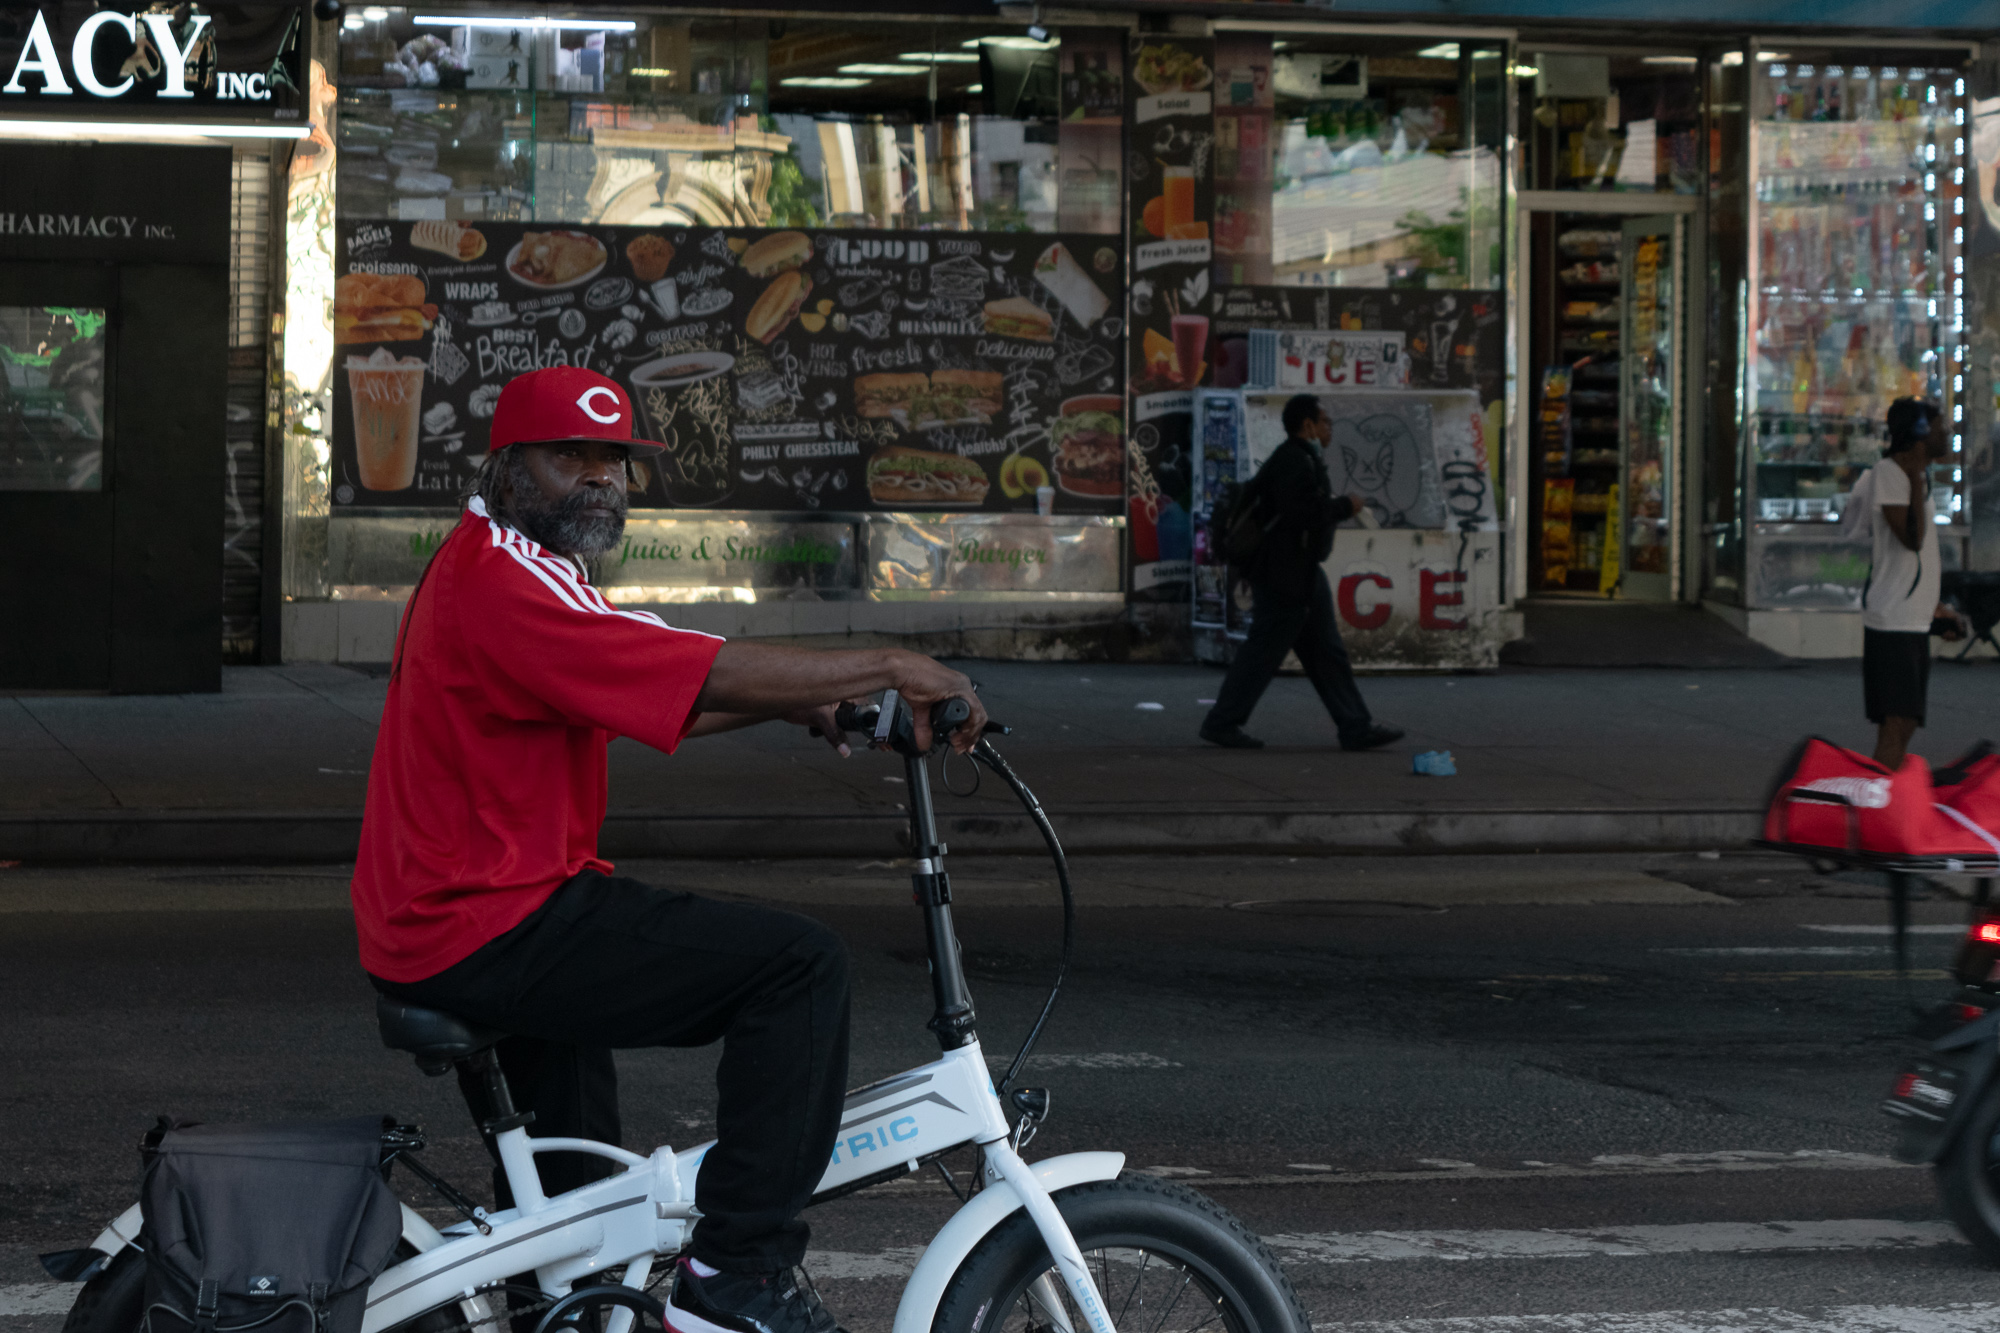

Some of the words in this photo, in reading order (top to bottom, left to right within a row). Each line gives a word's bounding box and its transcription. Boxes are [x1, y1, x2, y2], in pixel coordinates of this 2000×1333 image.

[2, 8, 212, 98] ACY
[216, 72, 272, 100] INC.
[347, 226, 391, 251] BAGELS
[1141, 247, 1172, 259] Fresh
[445, 282, 498, 300] WRAPS
[811, 343, 838, 360] HOT
[800, 359, 848, 378] WINGS
[1307, 360, 1375, 385] ICE
[576, 386, 622, 424] C
[1145, 397, 1194, 410] Smoothi
[742, 444, 780, 461] PHILLY
[785, 441, 859, 459] CHEESESTEAK
[418, 472, 465, 490] Latt
[618, 534, 682, 568] Juice
[691, 535, 711, 561] &
[955, 537, 1049, 572] Burger
[1338, 563, 1468, 630] CE
[1075, 1277, 1110, 1333] LECTRI
